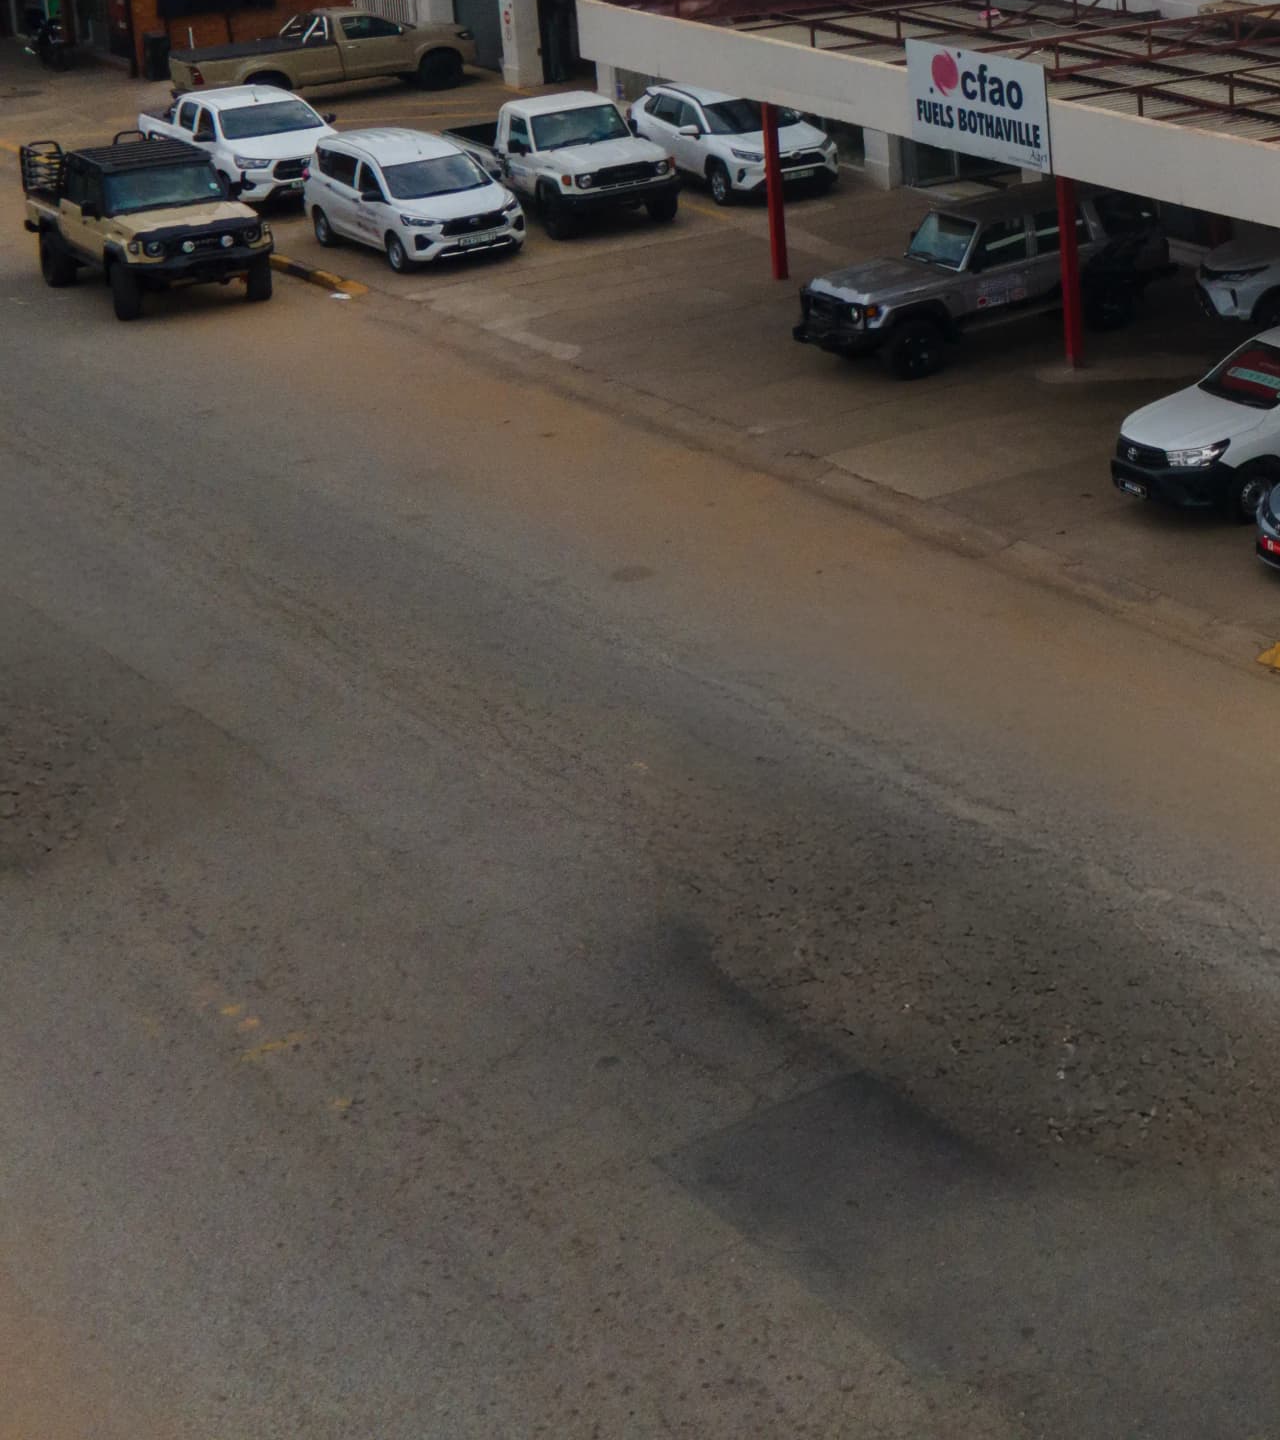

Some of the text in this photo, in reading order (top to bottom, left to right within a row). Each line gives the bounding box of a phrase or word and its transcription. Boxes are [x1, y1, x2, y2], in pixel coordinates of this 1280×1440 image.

[961, 63, 1023, 110] cfao
[916, 98, 1041, 149] FUELS BOTHAVILLE
